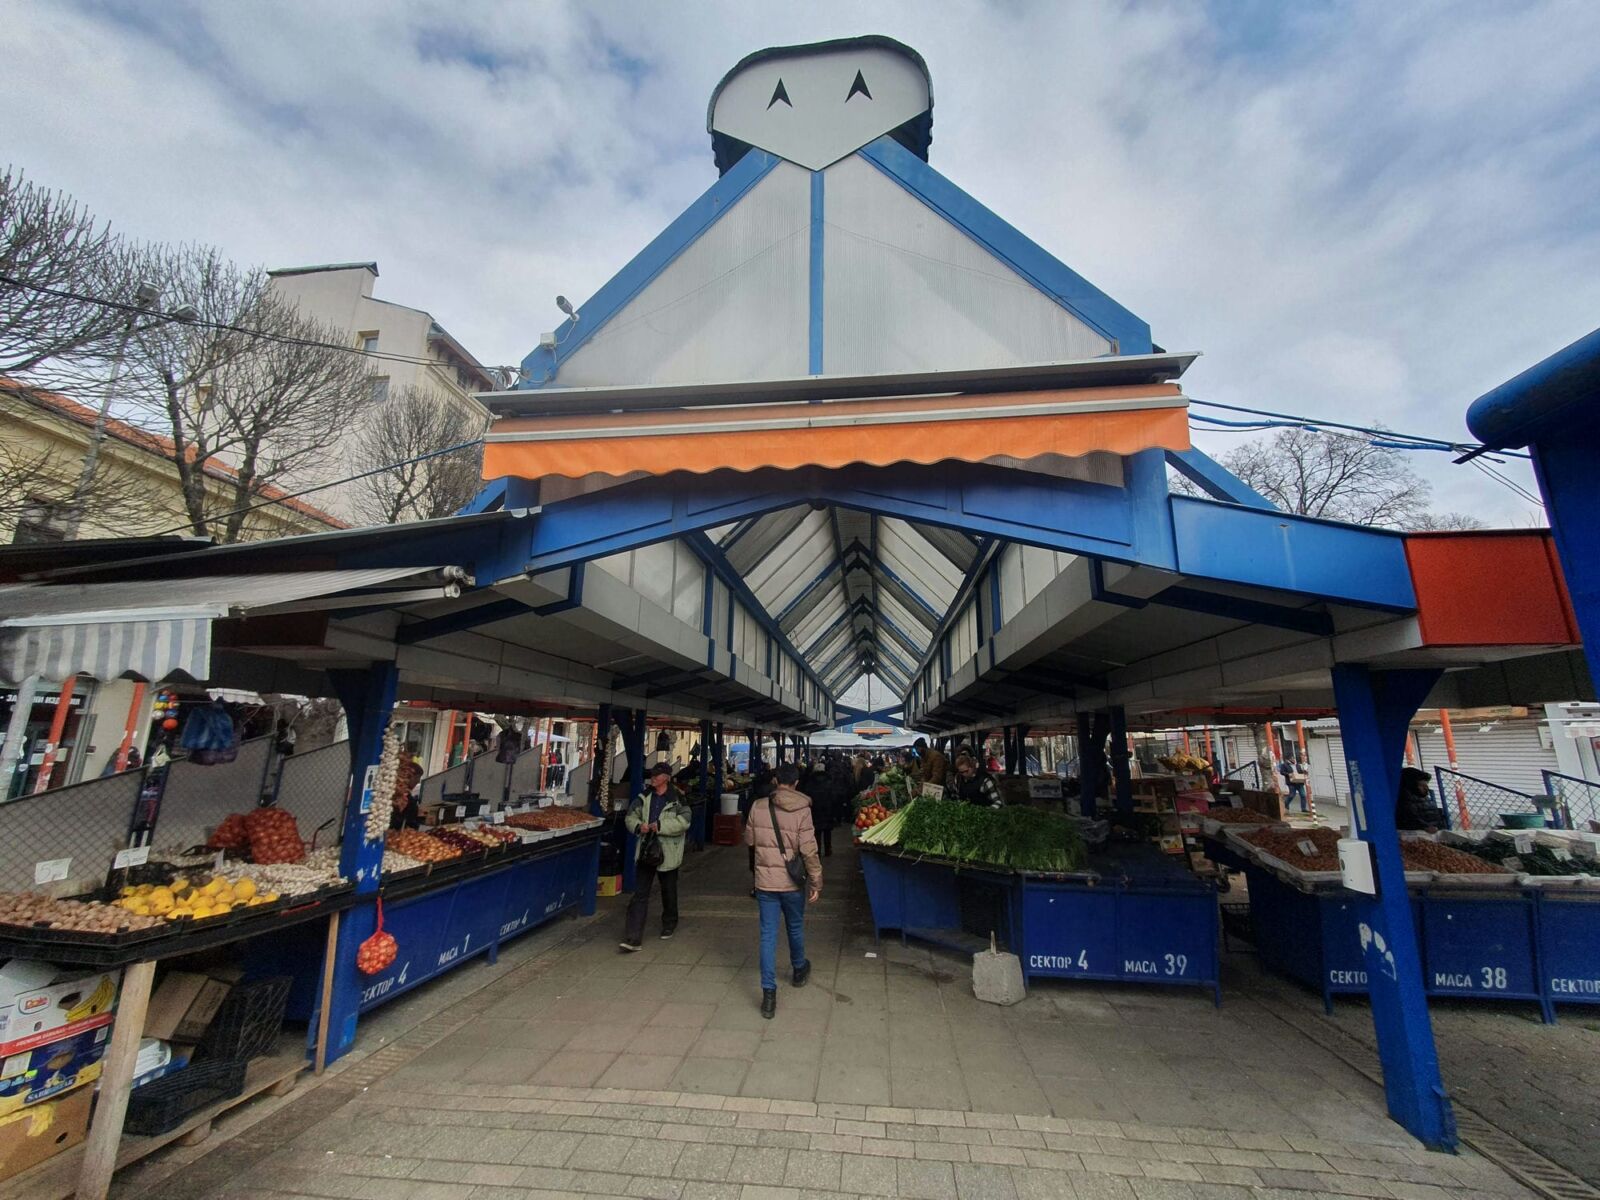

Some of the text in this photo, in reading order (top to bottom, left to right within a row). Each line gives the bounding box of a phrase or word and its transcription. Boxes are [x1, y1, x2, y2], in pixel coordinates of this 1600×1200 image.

[558, 892, 566, 908] 2
[499, 908, 529, 936] СЕКТОР 4
[398, 961, 410, 985] 4
[437, 946, 458, 966] МАСА
[463, 933, 471, 953] 1
[1030, 949, 1188, 976] СЕКТОР 4 МАСА 39
[1330, 966, 1507, 989] СЕКТО МАСА 38
